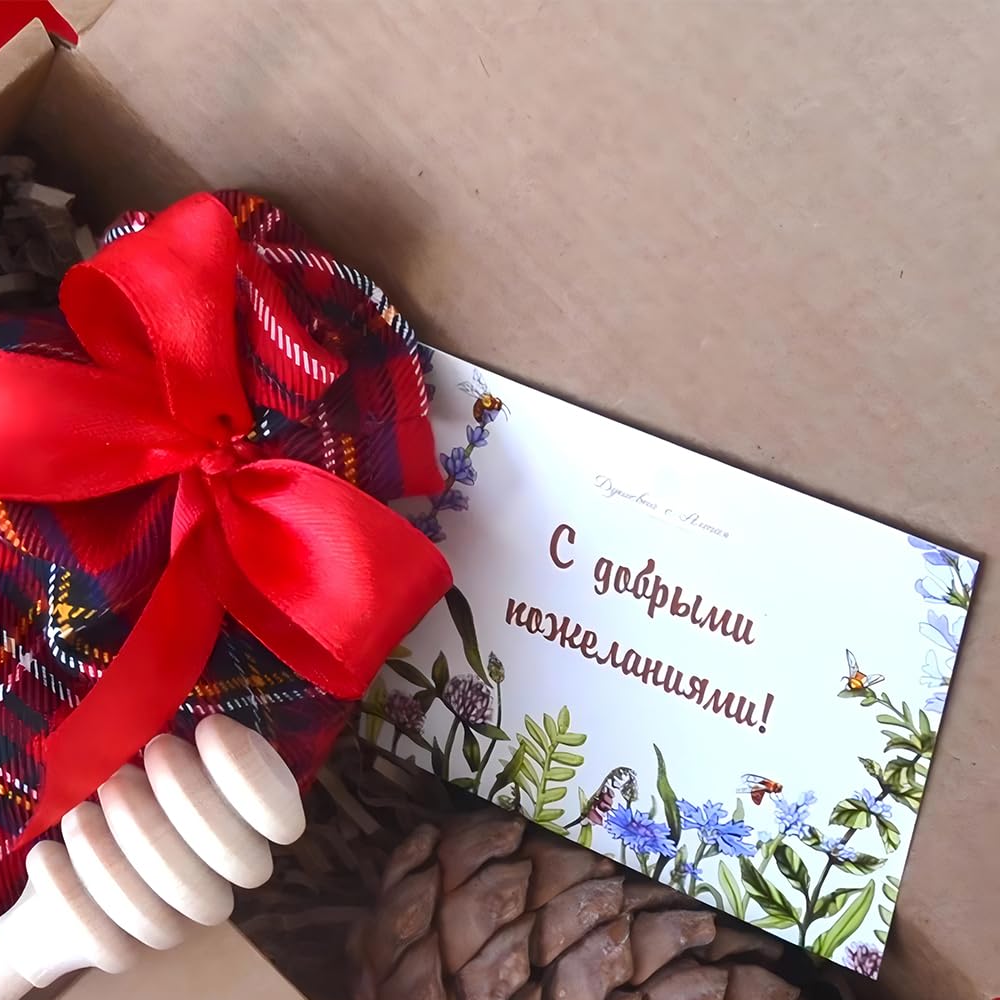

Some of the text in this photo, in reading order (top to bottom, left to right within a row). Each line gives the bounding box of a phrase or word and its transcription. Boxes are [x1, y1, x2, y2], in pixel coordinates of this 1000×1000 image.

[549, 523, 755, 645] С добрыми
[505, 598, 775, 734] пожеланиями!
